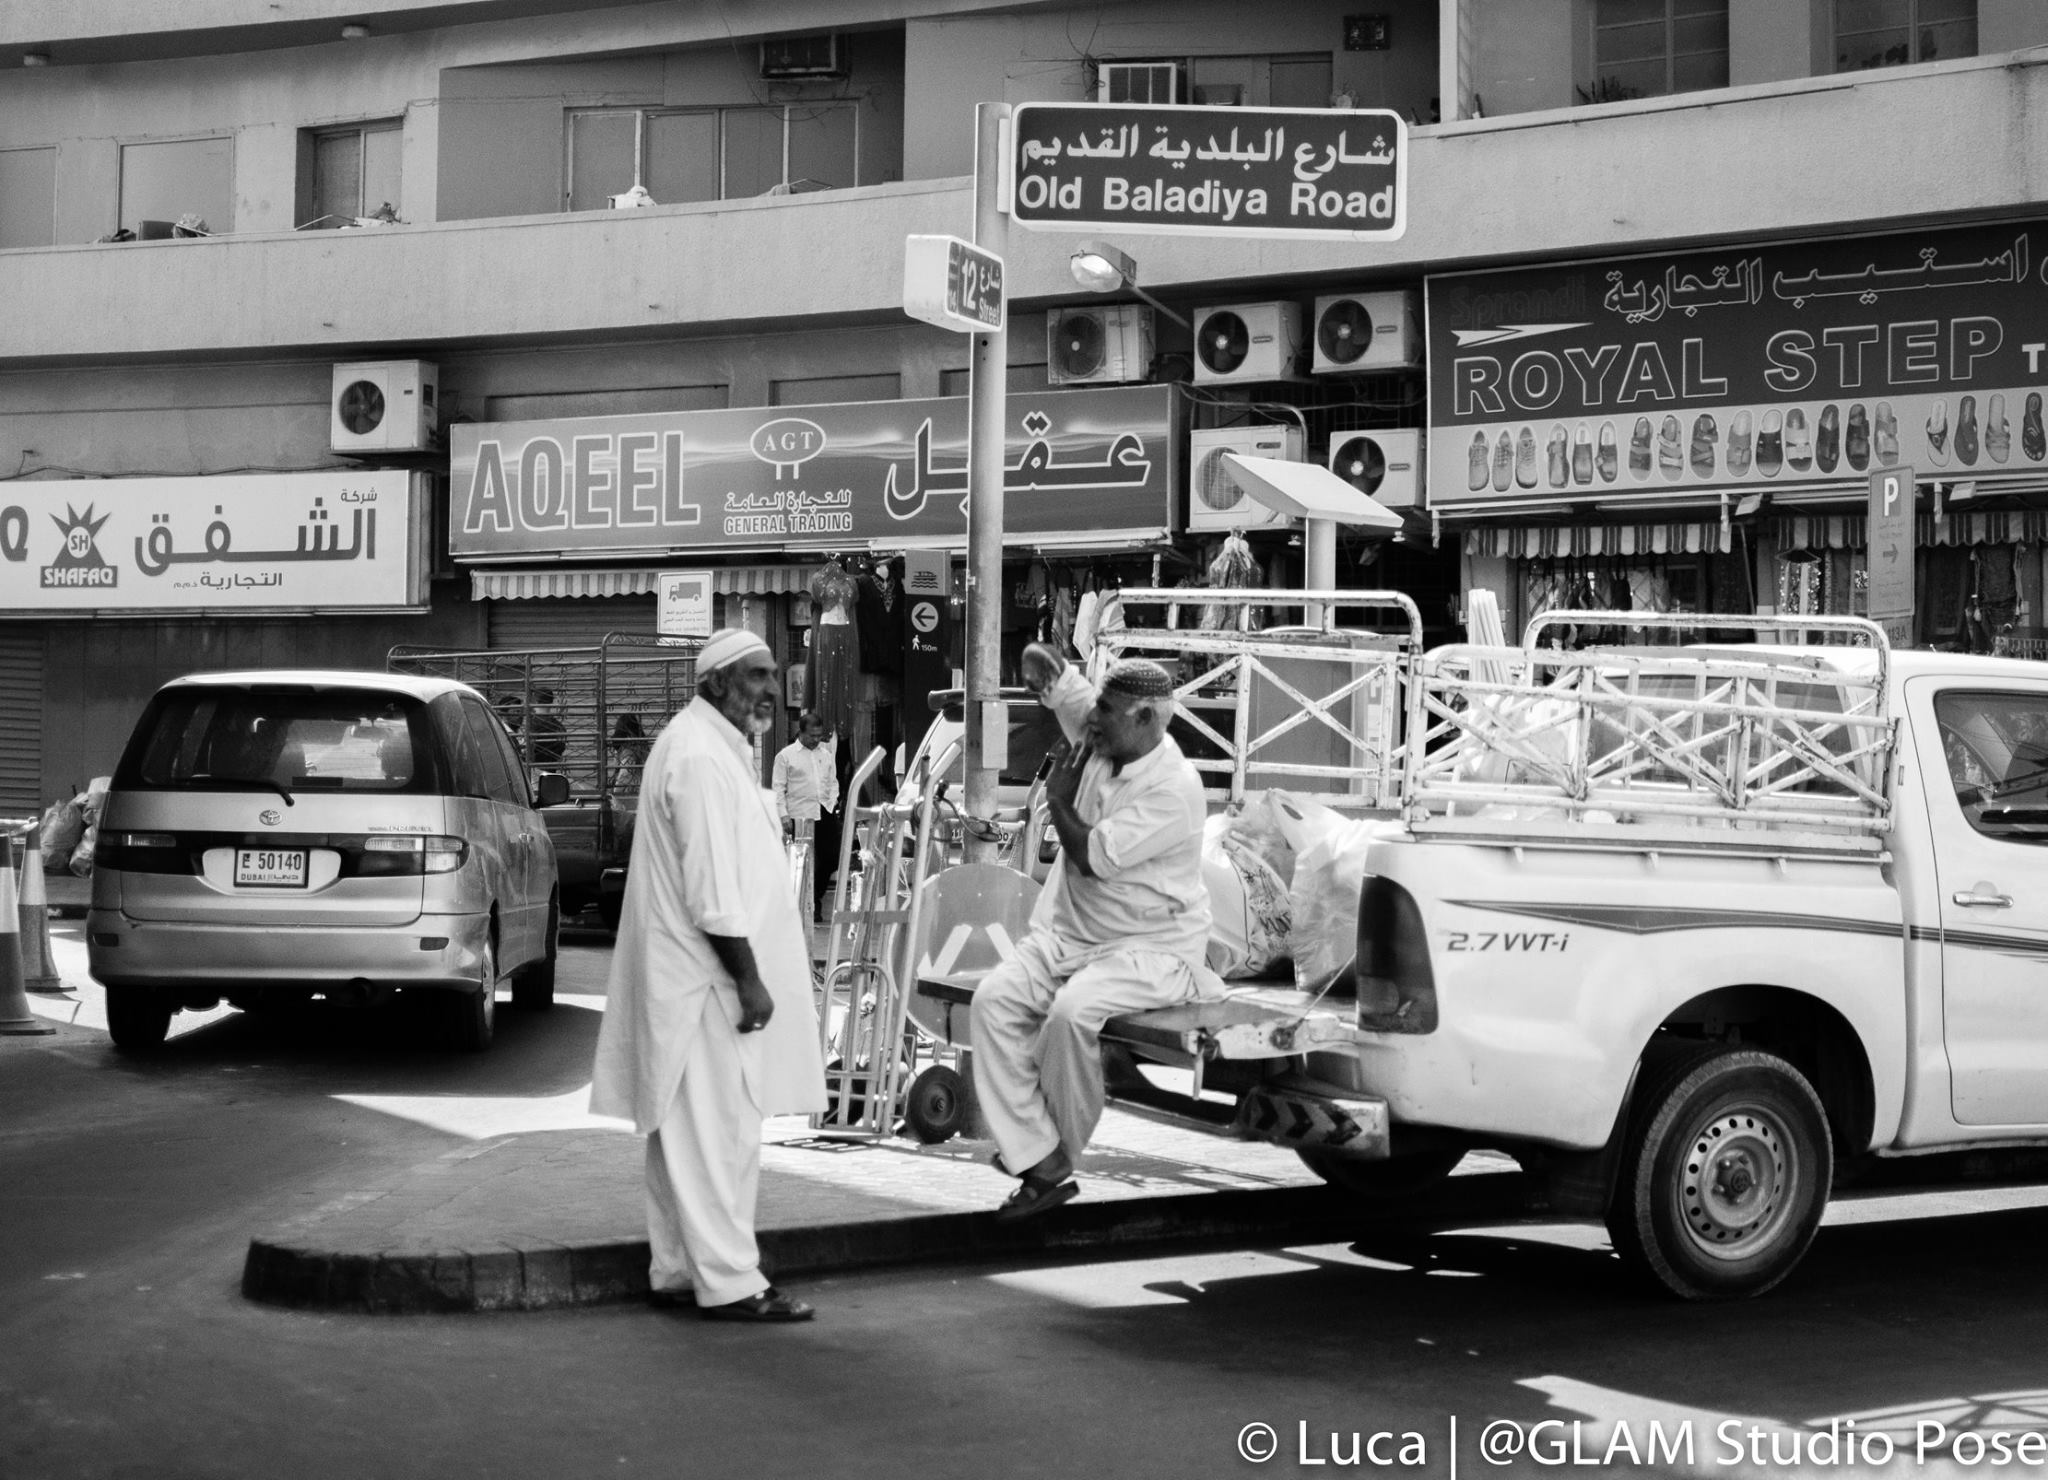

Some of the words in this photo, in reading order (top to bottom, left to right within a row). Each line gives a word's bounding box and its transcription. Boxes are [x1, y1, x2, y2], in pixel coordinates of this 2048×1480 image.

[1021, 123, 1139, 171] القديم
[1149, 125, 1284, 171] البلدية
[1294, 132, 1396, 181] شارع
[1019, 175, 1083, 210] Old
[1103, 177, 1268, 221] Baladiya
[1290, 183, 1394, 219] Road
[961, 258, 977, 311] 12
[980, 265, 1000, 293] شارع
[1604, 257, 1762, 324] التجارية
[979, 297, 1000, 326] Street
[1453, 337, 1728, 416] ROYAL
[1764, 315, 2004, 392] STEP
[763, 432, 815, 452] AGT
[340, 487, 378, 504] شركة
[463, 431, 702, 534] AQEEL
[724, 491, 785, 512] العامة
[786, 489, 852, 513] للتجارة
[1883, 477, 1899, 517] P
[134, 497, 376, 577] الشفق
[724, 514, 787, 536] GENERAL
[788, 512, 852, 533] TRADING
[70, 535, 88, 551] SH
[44, 567, 113, 586] SHAFAQ
[200, 571, 282, 590] التجارية
[921, 644, 938, 652] 150m
[242, 853, 250, 869] E
[258, 853, 302, 870] 50140
[1447, 932, 1498, 951] 2.7
[1503, 932, 1570, 951] VVT-i
